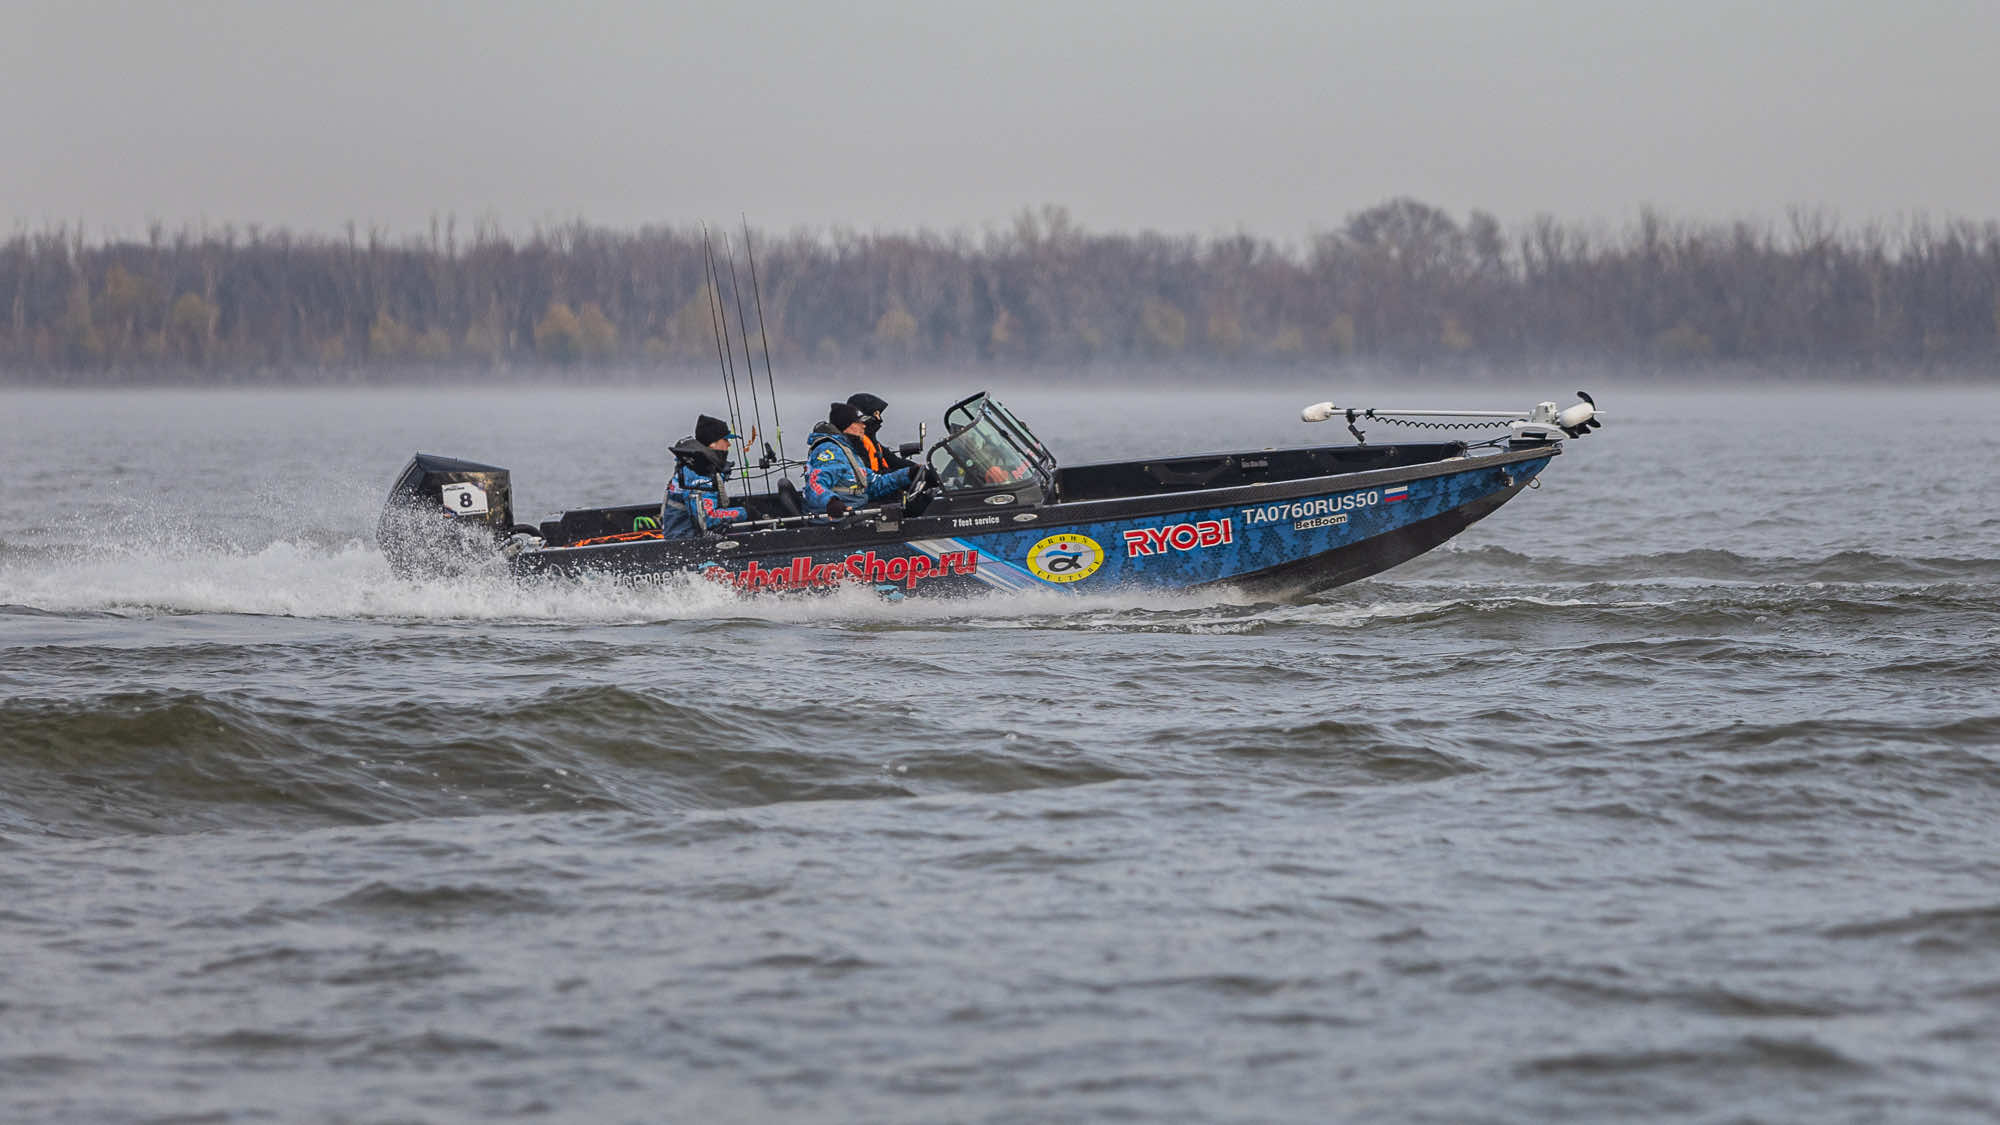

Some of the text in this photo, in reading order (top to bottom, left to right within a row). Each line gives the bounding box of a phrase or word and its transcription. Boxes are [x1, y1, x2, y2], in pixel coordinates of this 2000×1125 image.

[460, 492, 473, 507] 8
[1242, 491, 1379, 524] TA0760RUS50
[952, 518, 958, 528] 7
[974, 515, 1000, 526] service
[1295, 514, 1347, 530] BetBoom
[1123, 518, 1233, 557] RYOBI
